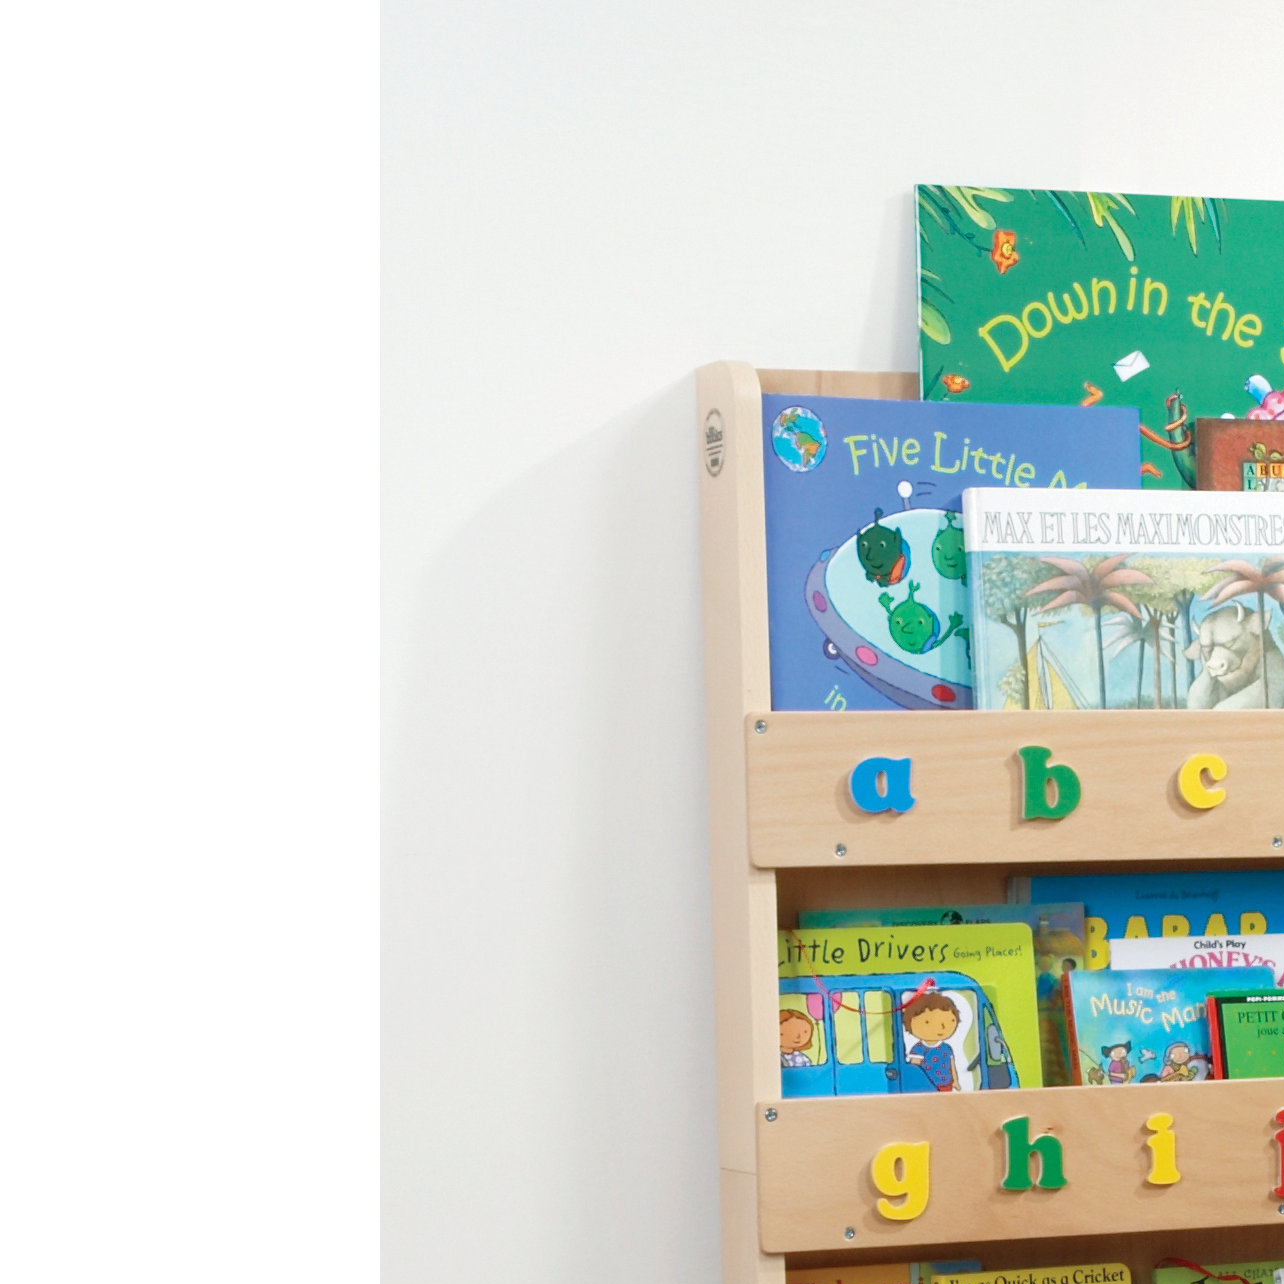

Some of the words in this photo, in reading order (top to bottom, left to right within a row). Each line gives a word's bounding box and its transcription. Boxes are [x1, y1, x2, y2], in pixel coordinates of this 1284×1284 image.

[978, 277, 1117, 373] Down
[1126, 266, 1168, 316] in
[1187, 291, 1263, 348] the
[844, 433, 921, 475] Five
[930, 431, 1036, 488] Little
[981, 511, 1035, 545] MAX
[1039, 511, 1067, 545] ET
[1070, 512, 1112, 545] LES
[849, 756, 917, 814] a
[1018, 744, 1082, 820] b
[1177, 753, 1229, 810] c
[778, 938, 845, 965] ittle
[857, 934, 949, 964] Drivers
[953, 946, 983, 962] Going
[985, 944, 1023, 957] Places!
[1193, 940, 1224, 950] Child's
[1225, 939, 1247, 950] Play
[1126, 982, 1133, 997] I
[1135, 986, 1155, 999] am
[1089, 993, 1155, 1025] Music
[1161, 1002, 1208, 1033] Man
[1237, 1010, 1277, 1024] PETIT
[1256, 1025, 1279, 1039] joue
[871, 1140, 931, 1221] g
[1000, 1115, 1068, 1190] h
[1145, 1112, 1182, 1185] i
